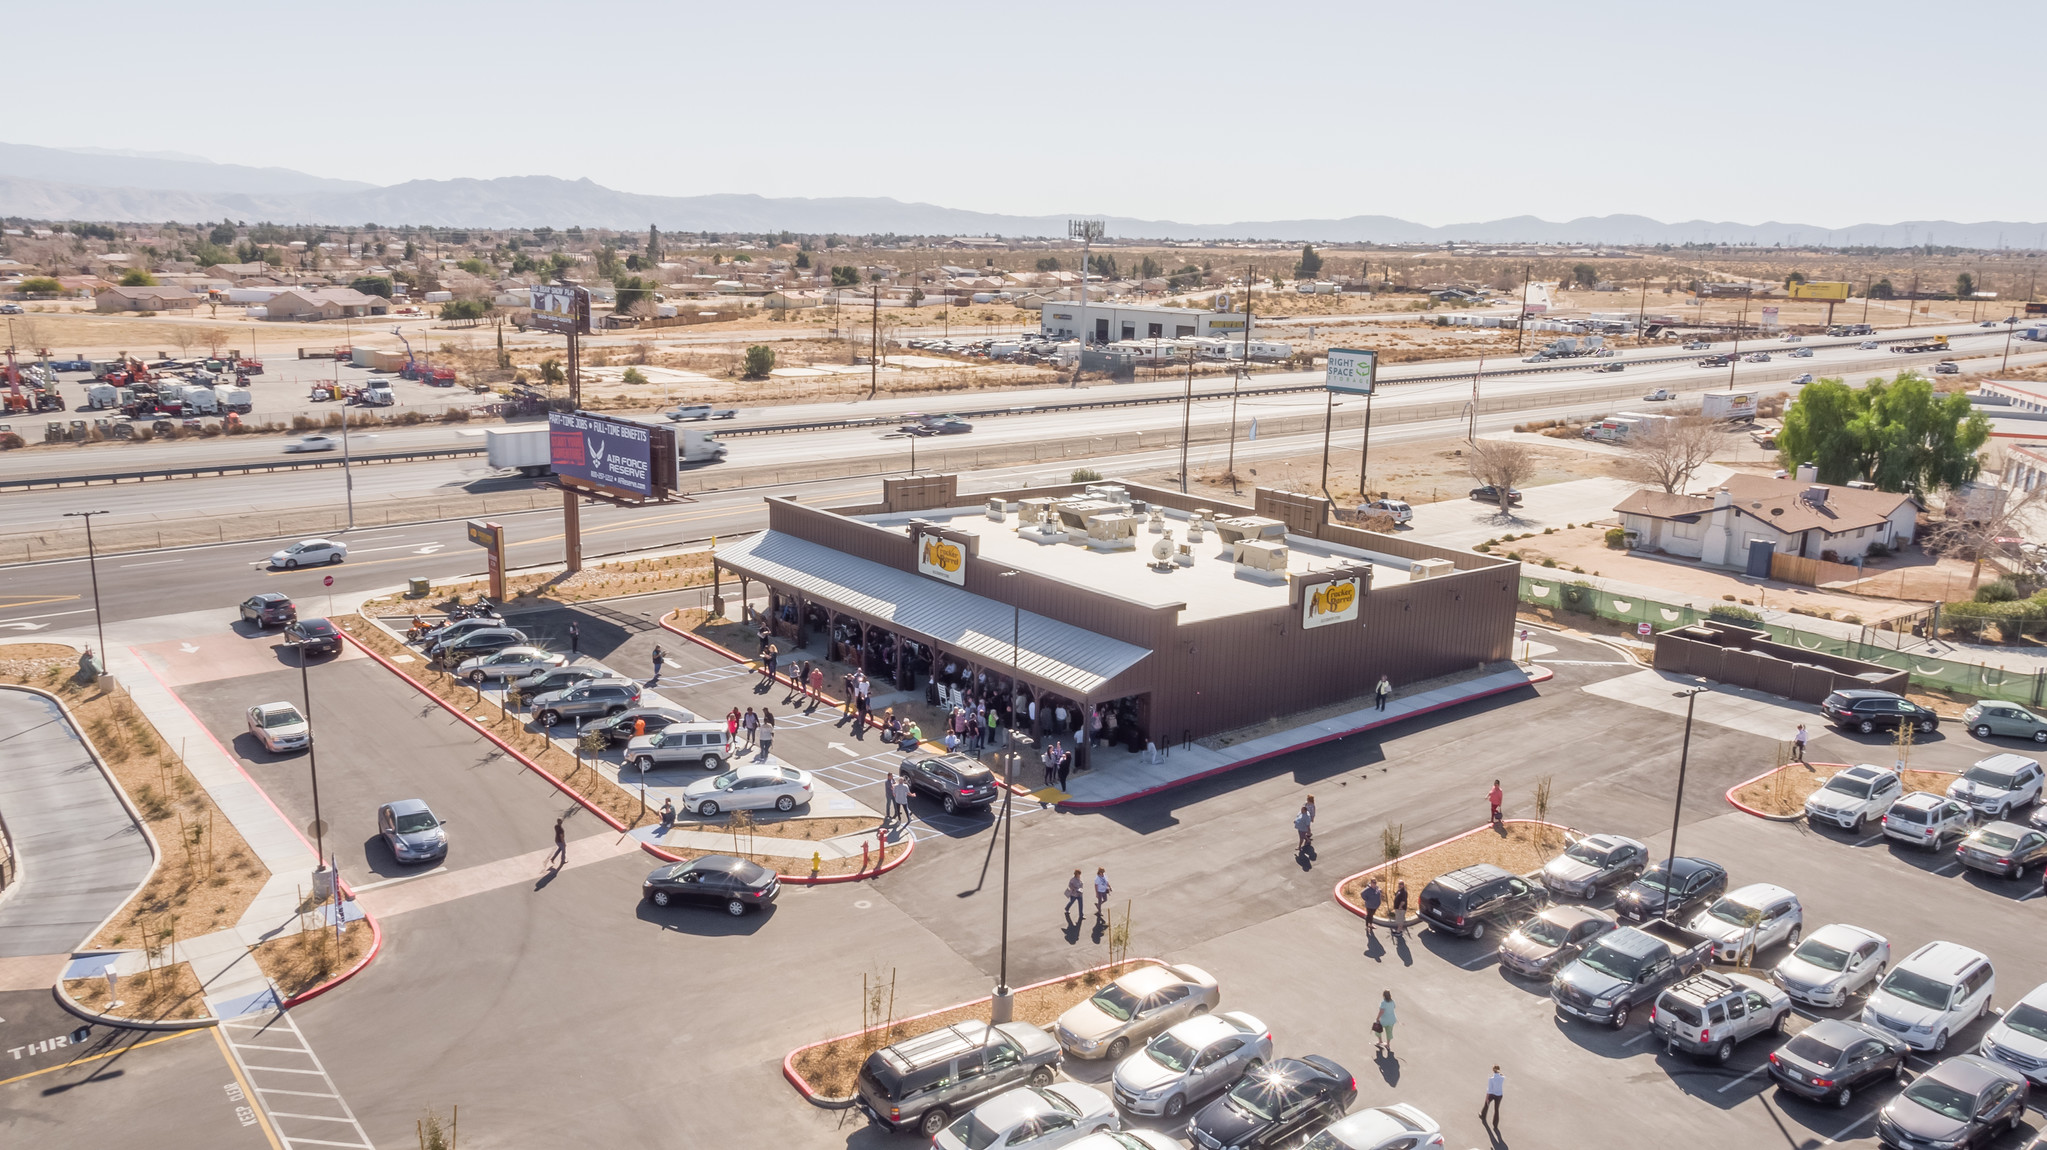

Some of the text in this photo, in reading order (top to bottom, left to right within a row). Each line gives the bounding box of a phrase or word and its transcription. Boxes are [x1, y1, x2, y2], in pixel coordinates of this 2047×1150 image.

[1329, 357, 1354, 367] RIGHT
[1328, 366, 1354, 377] SPACE
[548, 412, 647, 442] PART-TIME JOBS FULL-TIME BENEFITS
[607, 453, 648, 470] AIR FORCE
[609, 463, 646, 480] RESERVE
[1326, 588, 1353, 604] Cracker
[1330, 596, 1353, 613] Barrel
[223, 1081, 259, 1127] KEEP CLEAR
